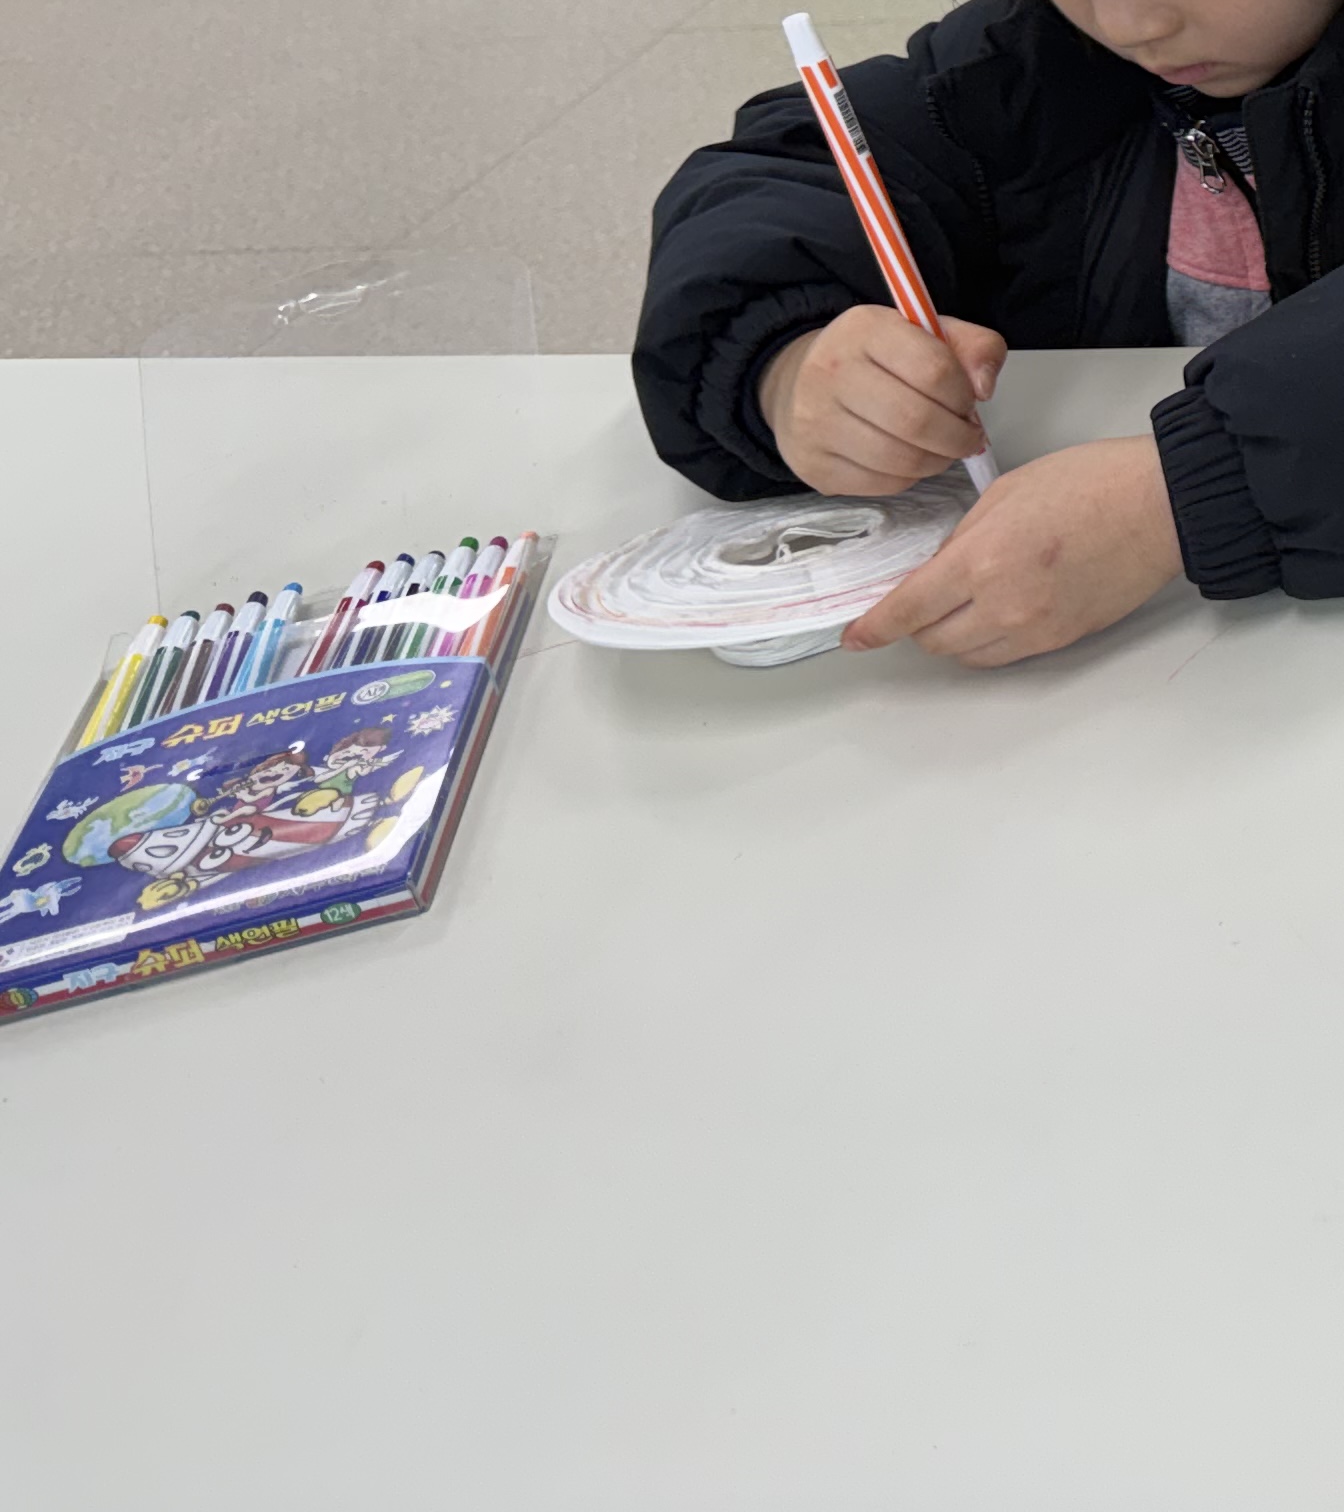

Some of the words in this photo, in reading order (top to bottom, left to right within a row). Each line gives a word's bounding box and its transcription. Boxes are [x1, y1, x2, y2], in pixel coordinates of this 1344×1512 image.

[160, 713, 245, 749] 슈퍼
[246, 691, 347, 727] 색연필
[323, 904, 356, 923] 12색
[130, 938, 206, 978] 슈퍼
[214, 918, 301, 952] 색연필
